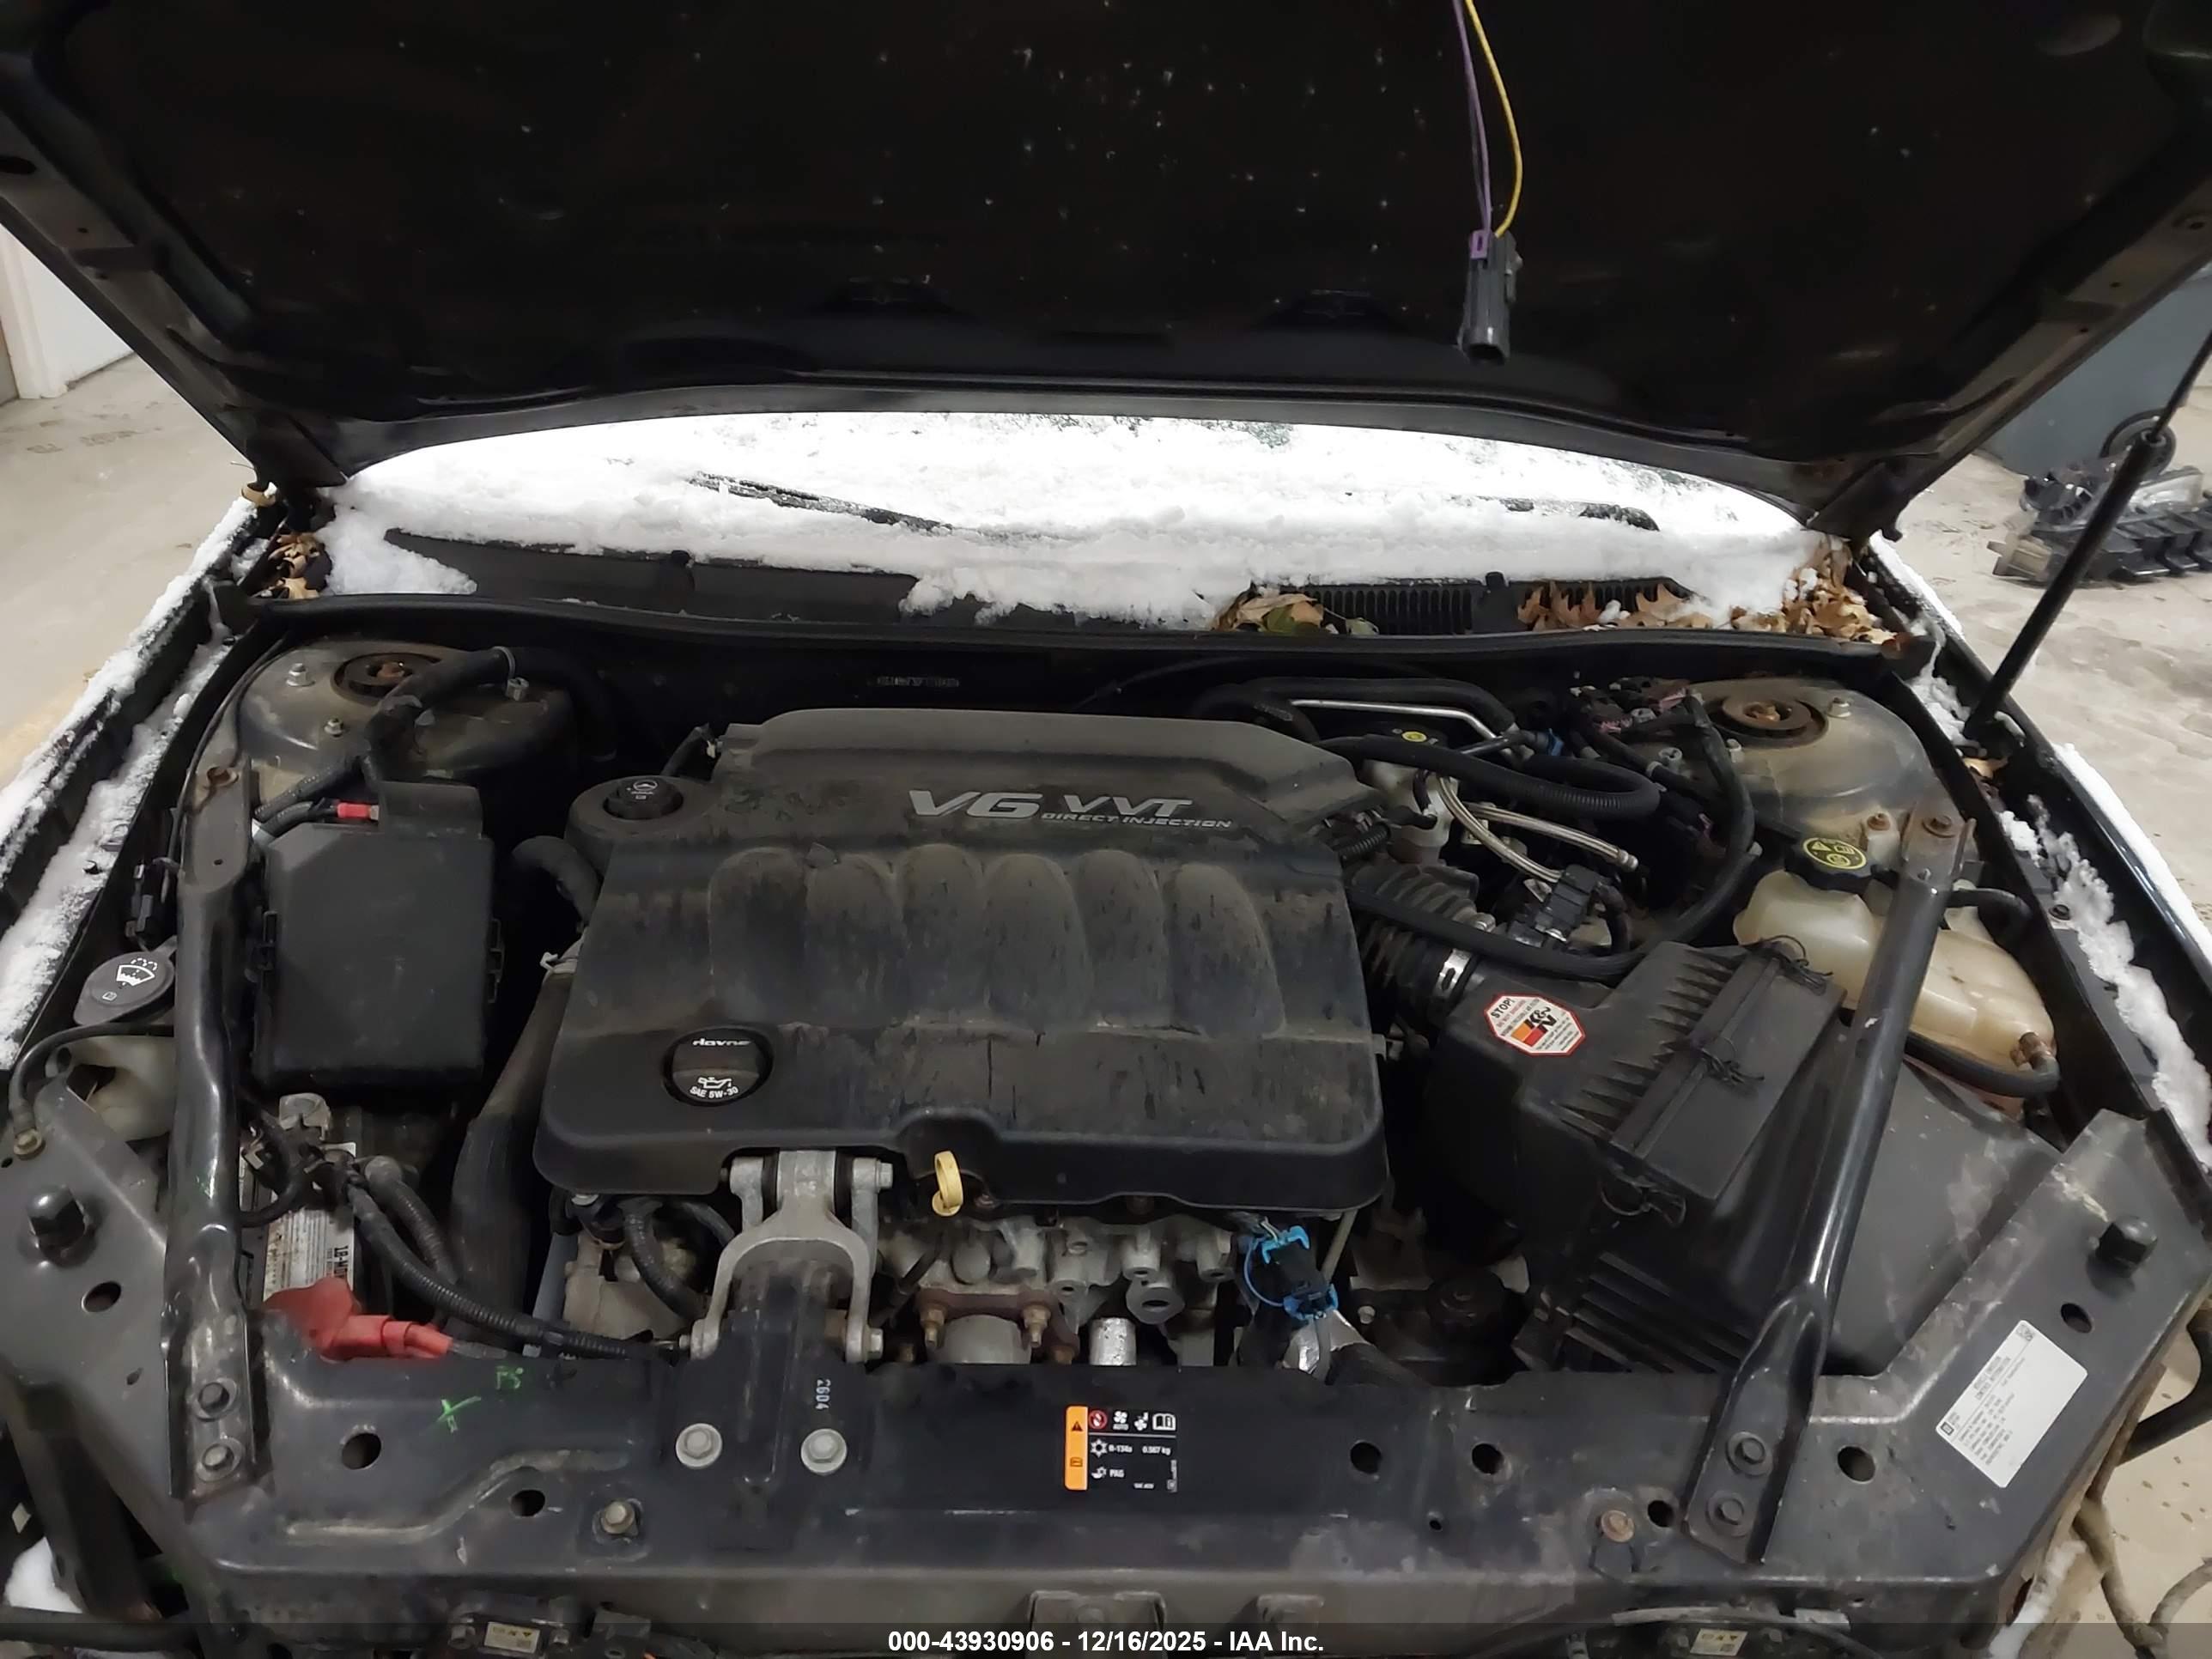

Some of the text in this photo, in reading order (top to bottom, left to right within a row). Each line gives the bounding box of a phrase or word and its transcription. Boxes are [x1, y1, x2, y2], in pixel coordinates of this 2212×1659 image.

[908, 789, 1194, 819] V6 VVT
[1041, 811, 1233, 829] DIRECT INJECTION
[1491, 997, 1516, 1018] STOP!
[1523, 1006, 1558, 1033] K&N
[690, 1085, 739, 1099] SAE 5W-30
